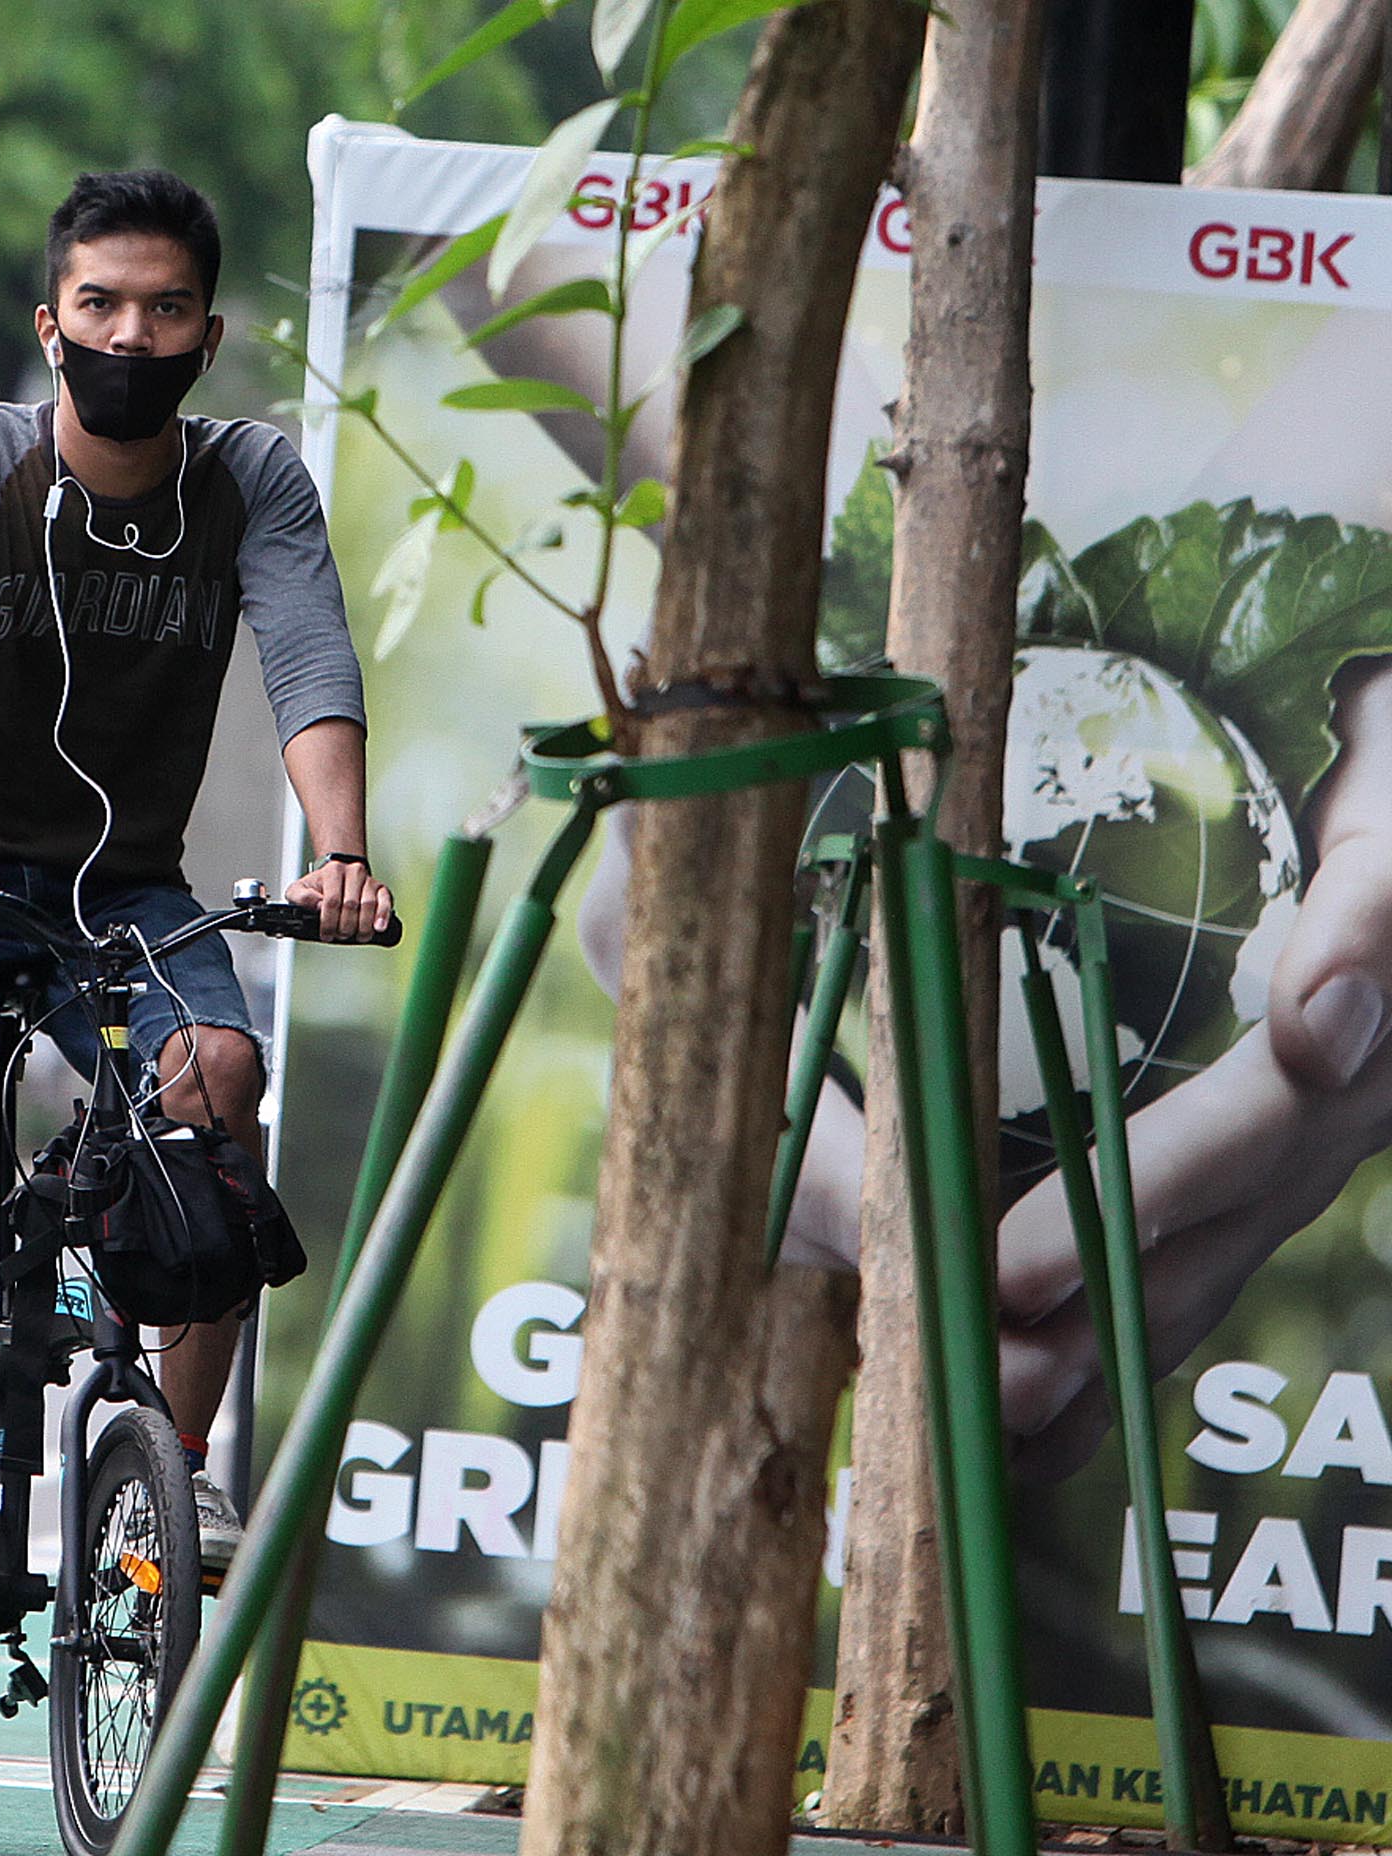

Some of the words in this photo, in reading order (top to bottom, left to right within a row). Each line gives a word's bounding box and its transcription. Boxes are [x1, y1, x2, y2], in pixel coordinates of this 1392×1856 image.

[1189, 222, 1355, 288] GBK
[470, 1281, 587, 1408] G
[1185, 1361, 1392, 1485] SA
[1118, 1505, 1392, 1636] EAR
[384, 1700, 536, 1744] UTAMA
[1034, 1761, 1100, 1798] AN
[1112, 1766, 1386, 1824] KEHATAN
